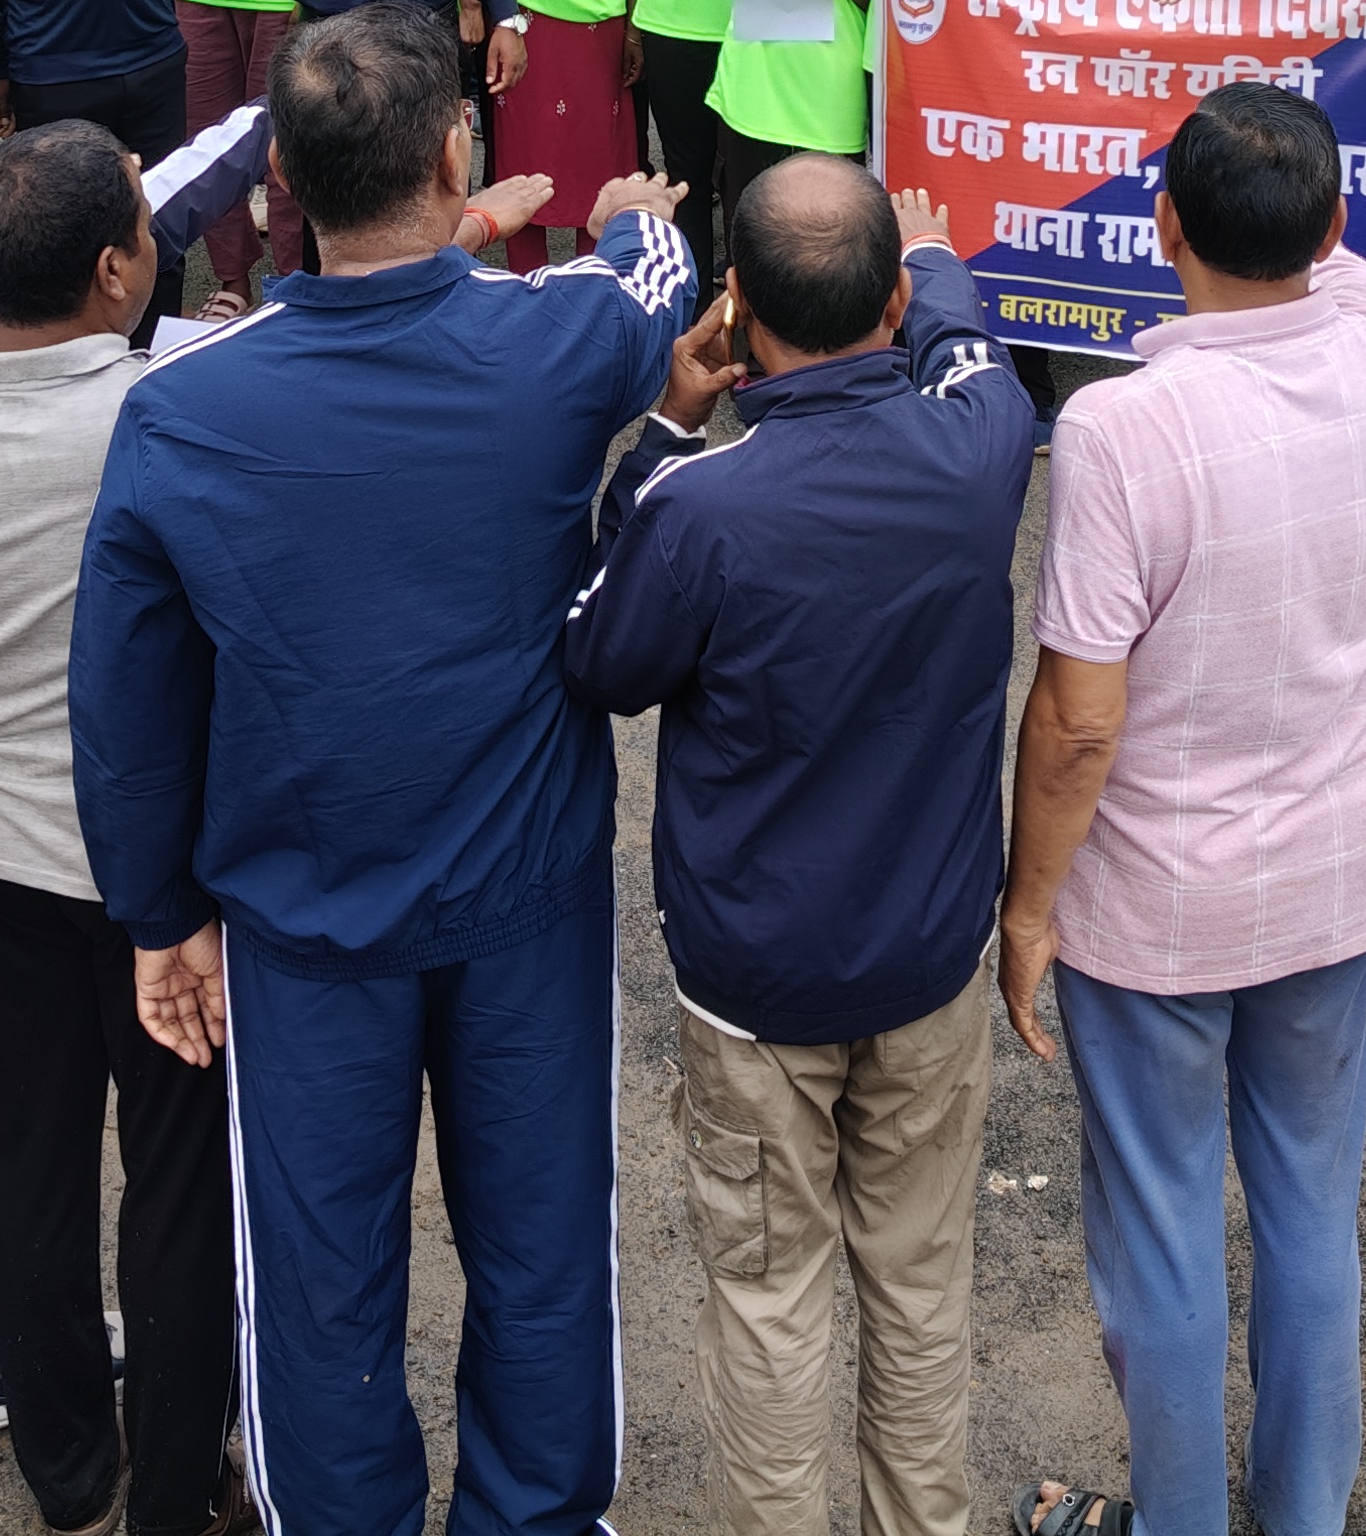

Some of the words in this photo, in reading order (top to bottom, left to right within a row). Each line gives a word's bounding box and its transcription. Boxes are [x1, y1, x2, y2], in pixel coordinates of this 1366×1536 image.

[1020, 50, 1083, 94] रन
[1090, 48, 1177, 100] फॉर
[920, 108, 1010, 164] एक
[1022, 122, 1165, 190] भारत,
[993, 201, 1090, 260] थाना
[998, 292, 1128, 342] बलरामपुर
